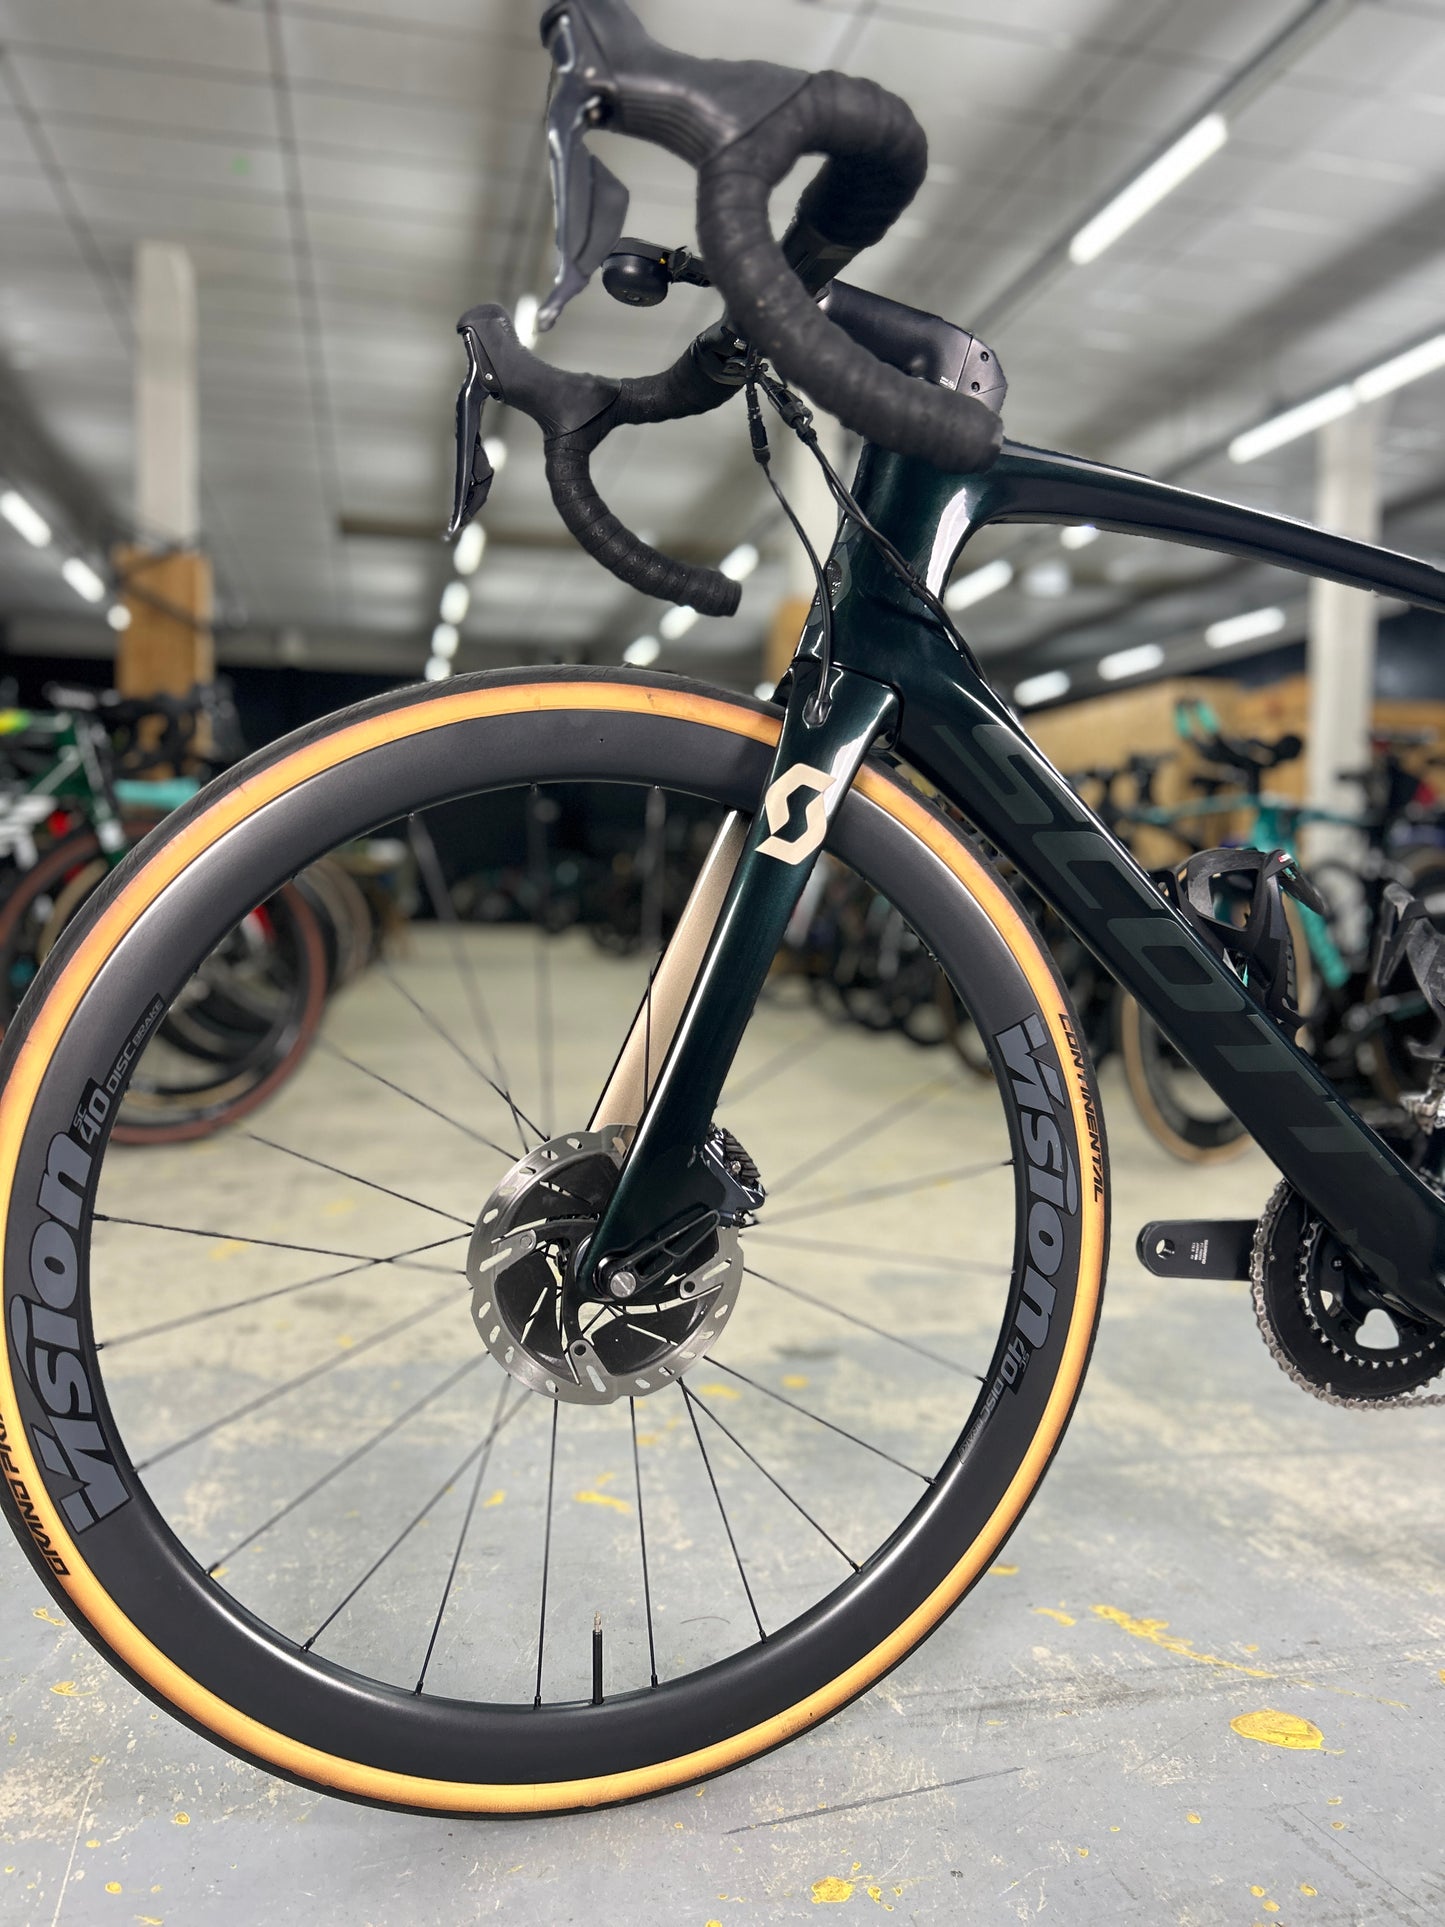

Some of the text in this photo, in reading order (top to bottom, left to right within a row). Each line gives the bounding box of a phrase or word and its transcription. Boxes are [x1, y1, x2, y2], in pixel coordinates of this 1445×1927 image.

[932, 723, 1399, 1177] SCOTT
[73, 1103, 87, 1130] SC
[79, 999, 164, 1145] 40 DISC BRAKE
[1058, 1013, 1105, 1203] CONTINENTAL
[980, 1376, 1005, 1422] DISC
[1000, 1336, 1027, 1386] 40
[9, 1478, 70, 1575] GRAND
